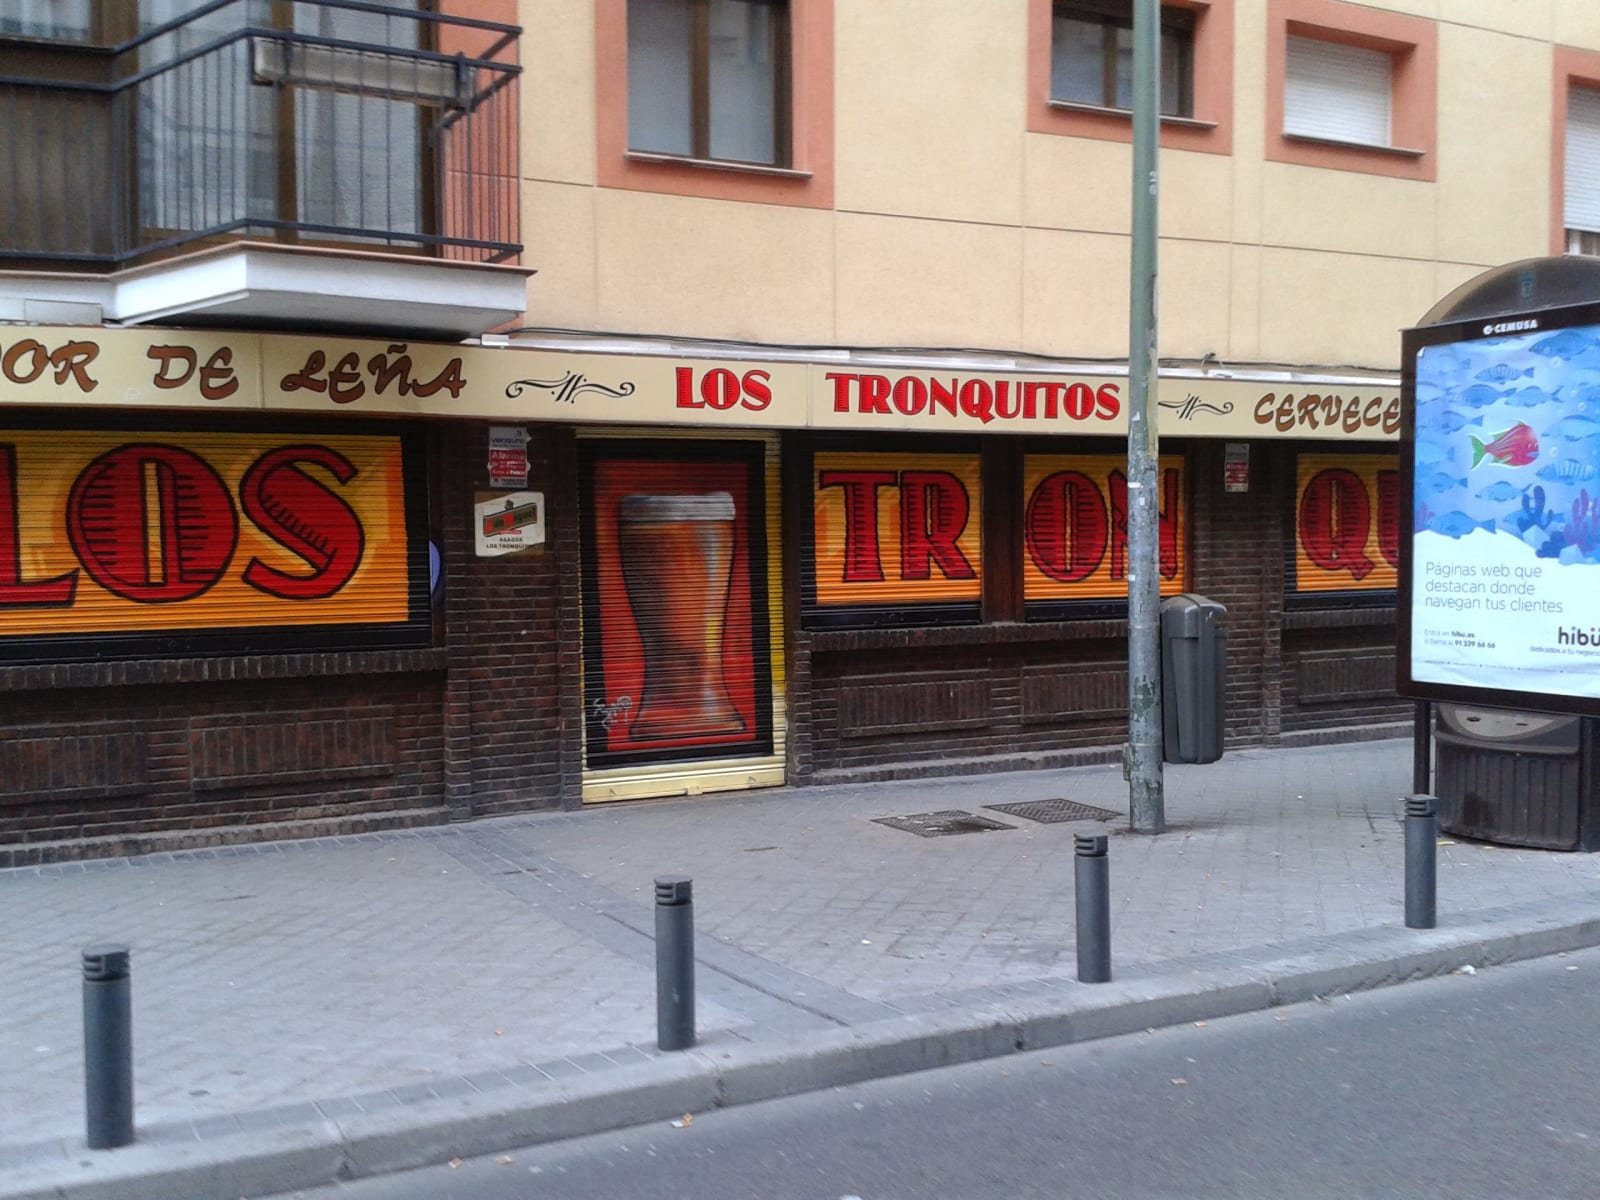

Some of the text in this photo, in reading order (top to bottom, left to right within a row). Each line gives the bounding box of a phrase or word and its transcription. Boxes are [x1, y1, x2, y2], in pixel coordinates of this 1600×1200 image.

[1494, 319, 1538, 333] CEMUSA
[0, 338, 467, 404] OR DE LEÑA
[675, 366, 1121, 424] LOS TRONQUITOS
[0, 442, 366, 609] LOS
[1425, 561, 1542, 579] Páginas web que
[1425, 580, 1535, 595] destacan donde
[1425, 596, 1563, 613] navegan tus clientes
